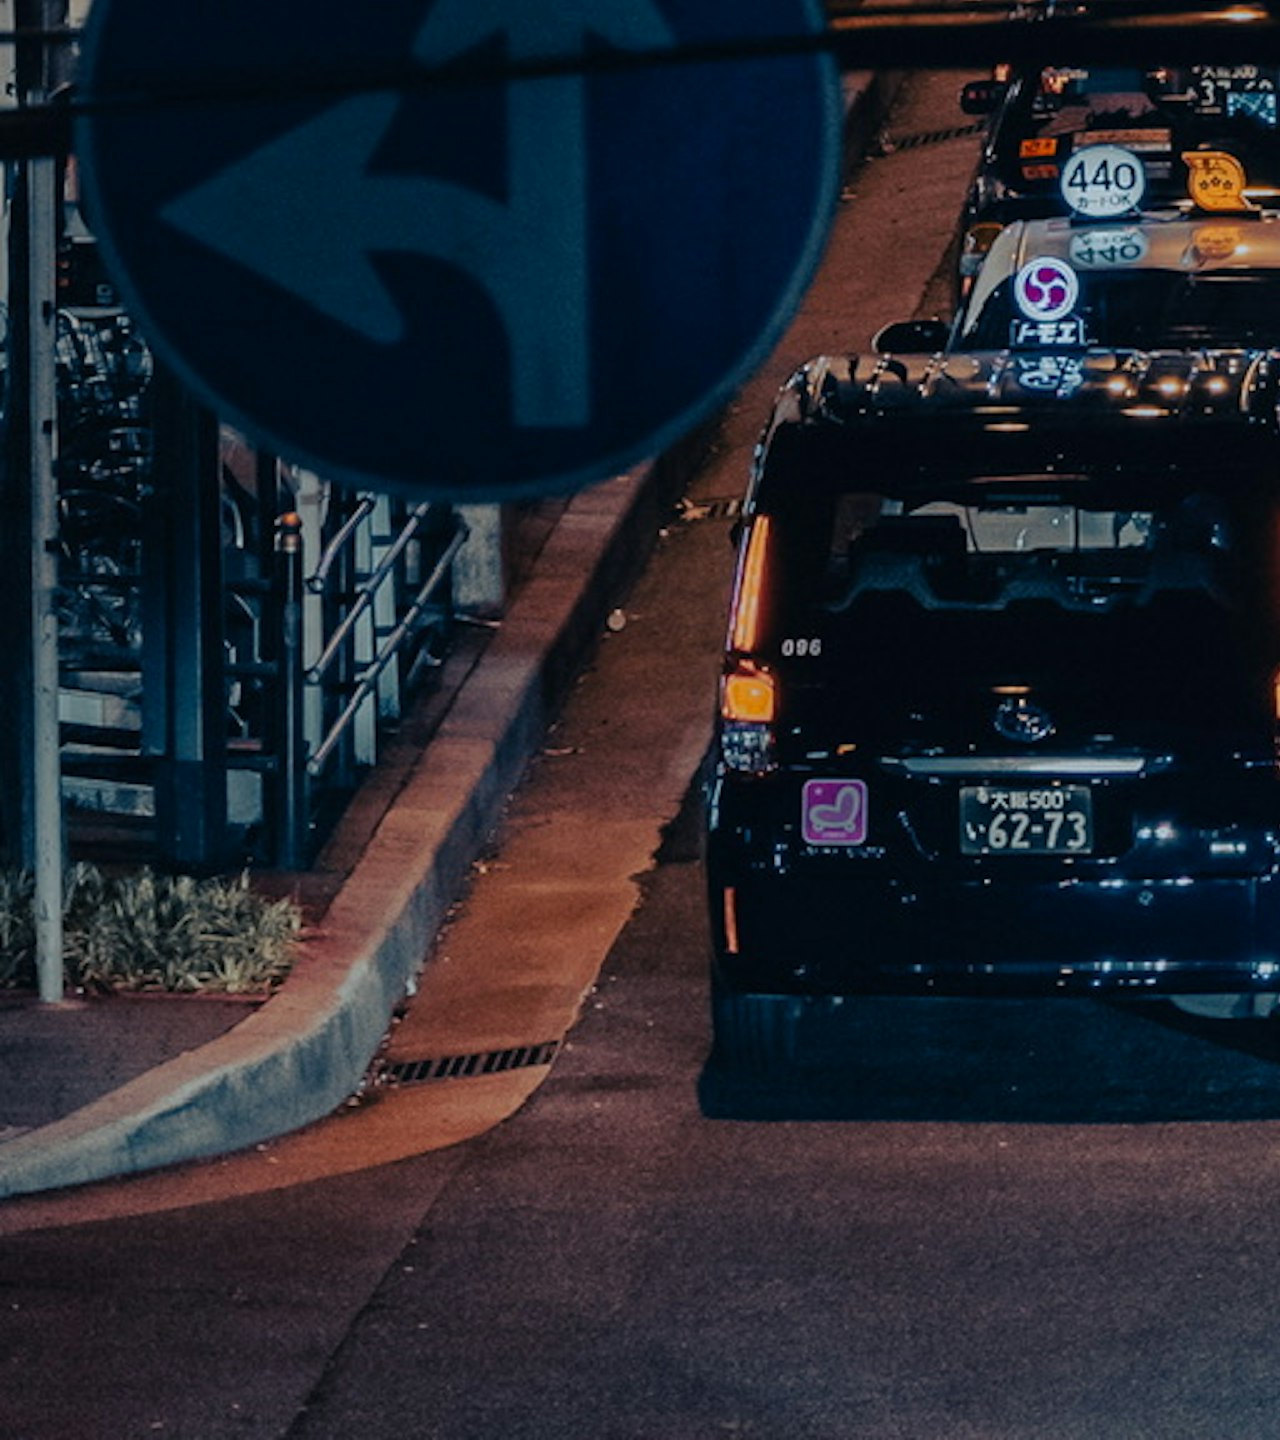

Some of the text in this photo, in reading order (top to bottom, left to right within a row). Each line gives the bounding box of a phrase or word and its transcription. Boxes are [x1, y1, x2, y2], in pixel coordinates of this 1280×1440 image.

[1067, 159, 1137, 192] 440
[1016, 321, 1077, 345] トモエ
[780, 637, 823, 657] 096
[988, 810, 1087, 849] 62-73
